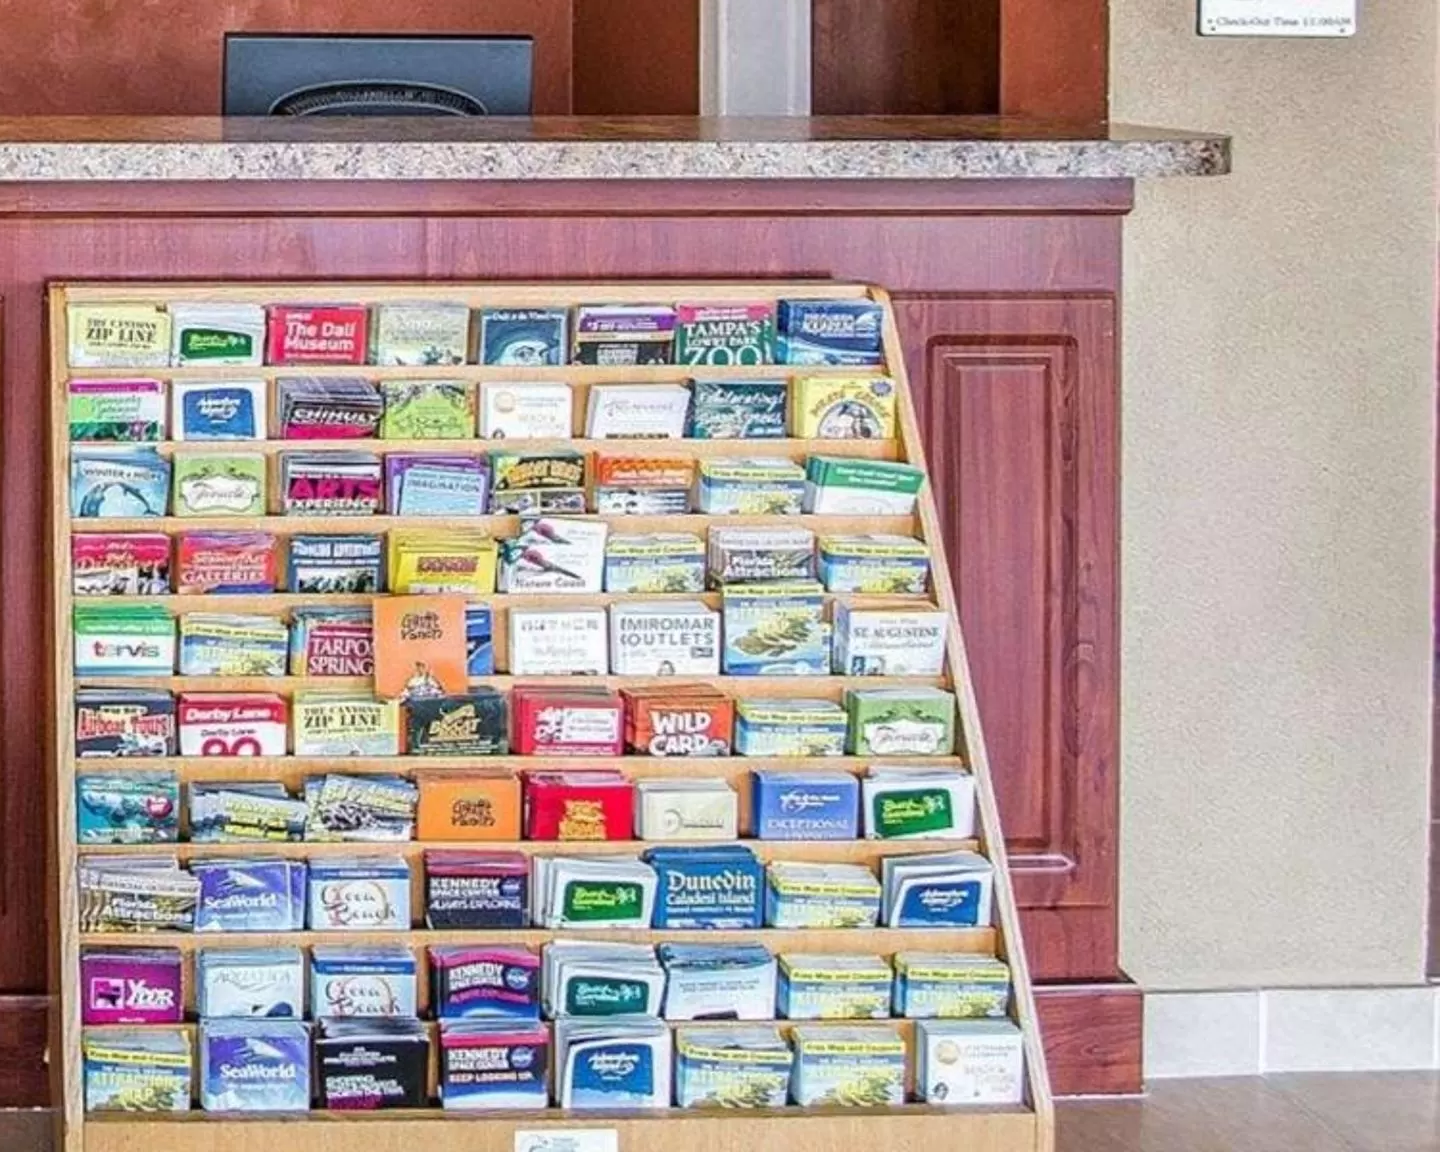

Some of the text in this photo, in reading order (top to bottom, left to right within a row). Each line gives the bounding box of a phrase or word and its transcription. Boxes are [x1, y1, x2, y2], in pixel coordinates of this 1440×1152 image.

[86, 328, 156, 343] ZIP LINE
[286, 322, 317, 337] The
[683, 321, 761, 337] TAMPA'S
[285, 337, 355, 351] Museum
[684, 346, 761, 365] ZOO
[93, 640, 160, 658] tervis
[310, 637, 374, 656] TARPO
[186, 708, 232, 722] Derby
[303, 714, 381, 729] ZIP LINE
[650, 709, 711, 734] WILD
[429, 877, 501, 890] KENNEDY
[666, 868, 756, 891] Dunedin
[203, 894, 278, 909] SeaWorld
[448, 1048, 508, 1060] KENNEDY
[220, 1063, 296, 1079] SeaWorld
